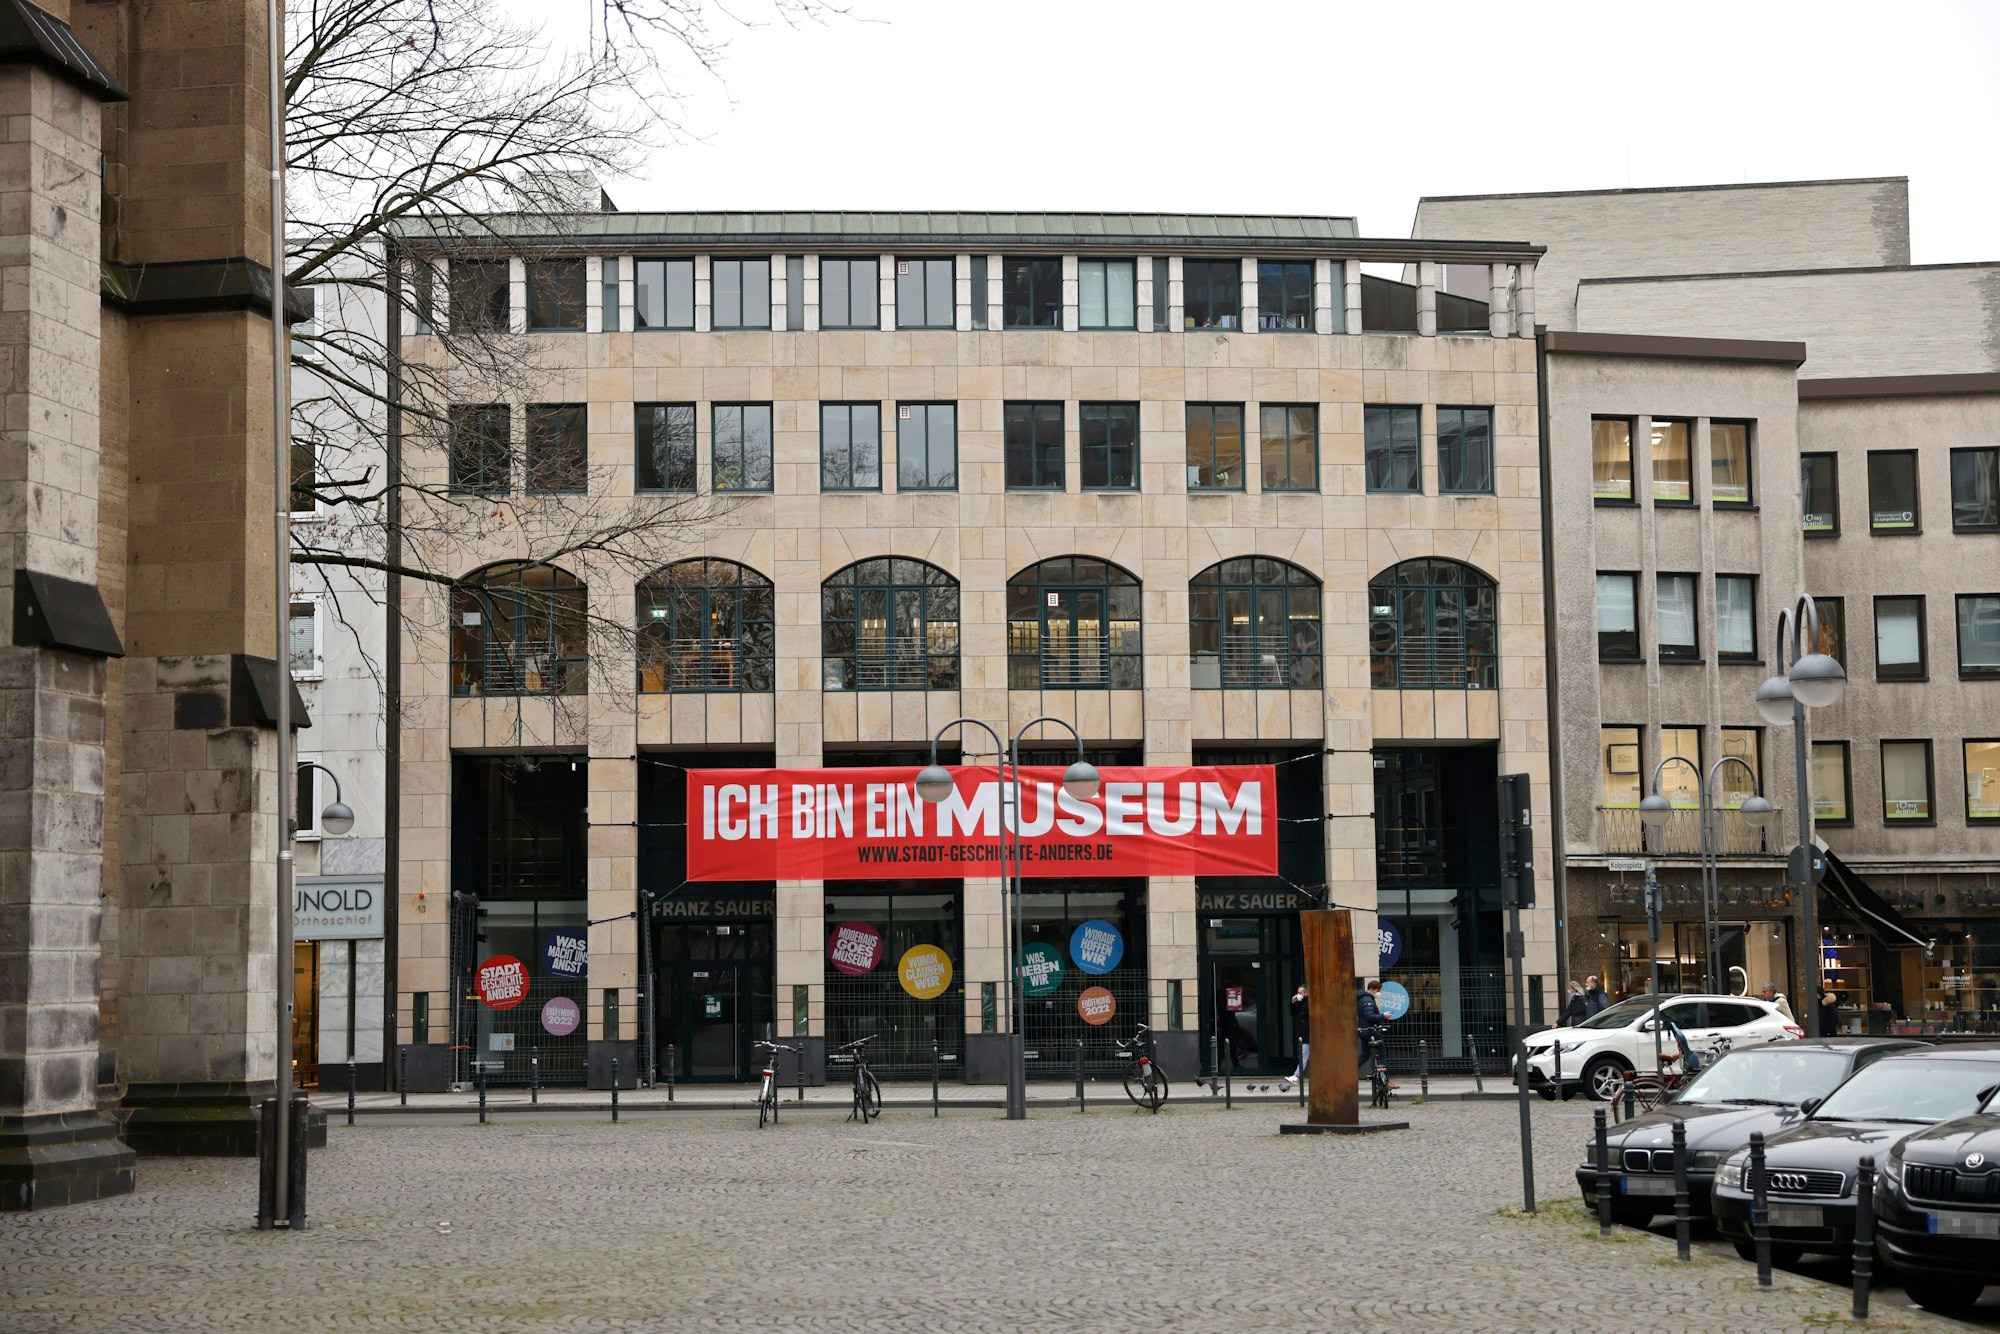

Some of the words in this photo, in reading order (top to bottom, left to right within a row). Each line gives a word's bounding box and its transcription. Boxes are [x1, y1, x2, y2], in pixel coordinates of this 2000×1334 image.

[703, 784, 778, 840] ICH
[792, 784, 853, 838] BIN
[866, 783, 924, 838] EIN
[936, 781, 1262, 837] MUSEUM
[857, 844, 1113, 863] WWW.STADT-GESCHICHTE-ANDERS.DE
[1610, 861, 1642, 870] Kolpingplatz
[652, 901, 710, 917] FRANZ
[714, 900, 775, 916] SAUER
[1240, 894, 1298, 910] SAUER
[556, 935, 586, 951] WAS
[838, 927, 878, 947] MODEHAUS
[1085, 927, 1116, 945] WORAUF
[547, 945, 574, 961] MACHT
[836, 938, 874, 957] GOES
[1080, 937, 1113, 957] HOFFEN
[552, 957, 582, 974] ANGST
[832, 948, 872, 969] MUSEUM
[907, 952, 938, 969] WORAN
[1025, 951, 1045, 965] WAS
[1081, 949, 1105, 966] WIR
[481, 963, 520, 979] STADT
[905, 962, 945, 981] GLAUBEN
[481, 973, 524, 991] GESCHICHTE
[913, 975, 941, 989] WIR
[1030, 973, 1049, 987] WIR
[486, 984, 522, 1002] ANDERS
[1085, 1004, 1110, 1016] 2022
[1379, 1000, 1402, 1011] 2022
[547, 1016, 573, 1025] 2022
